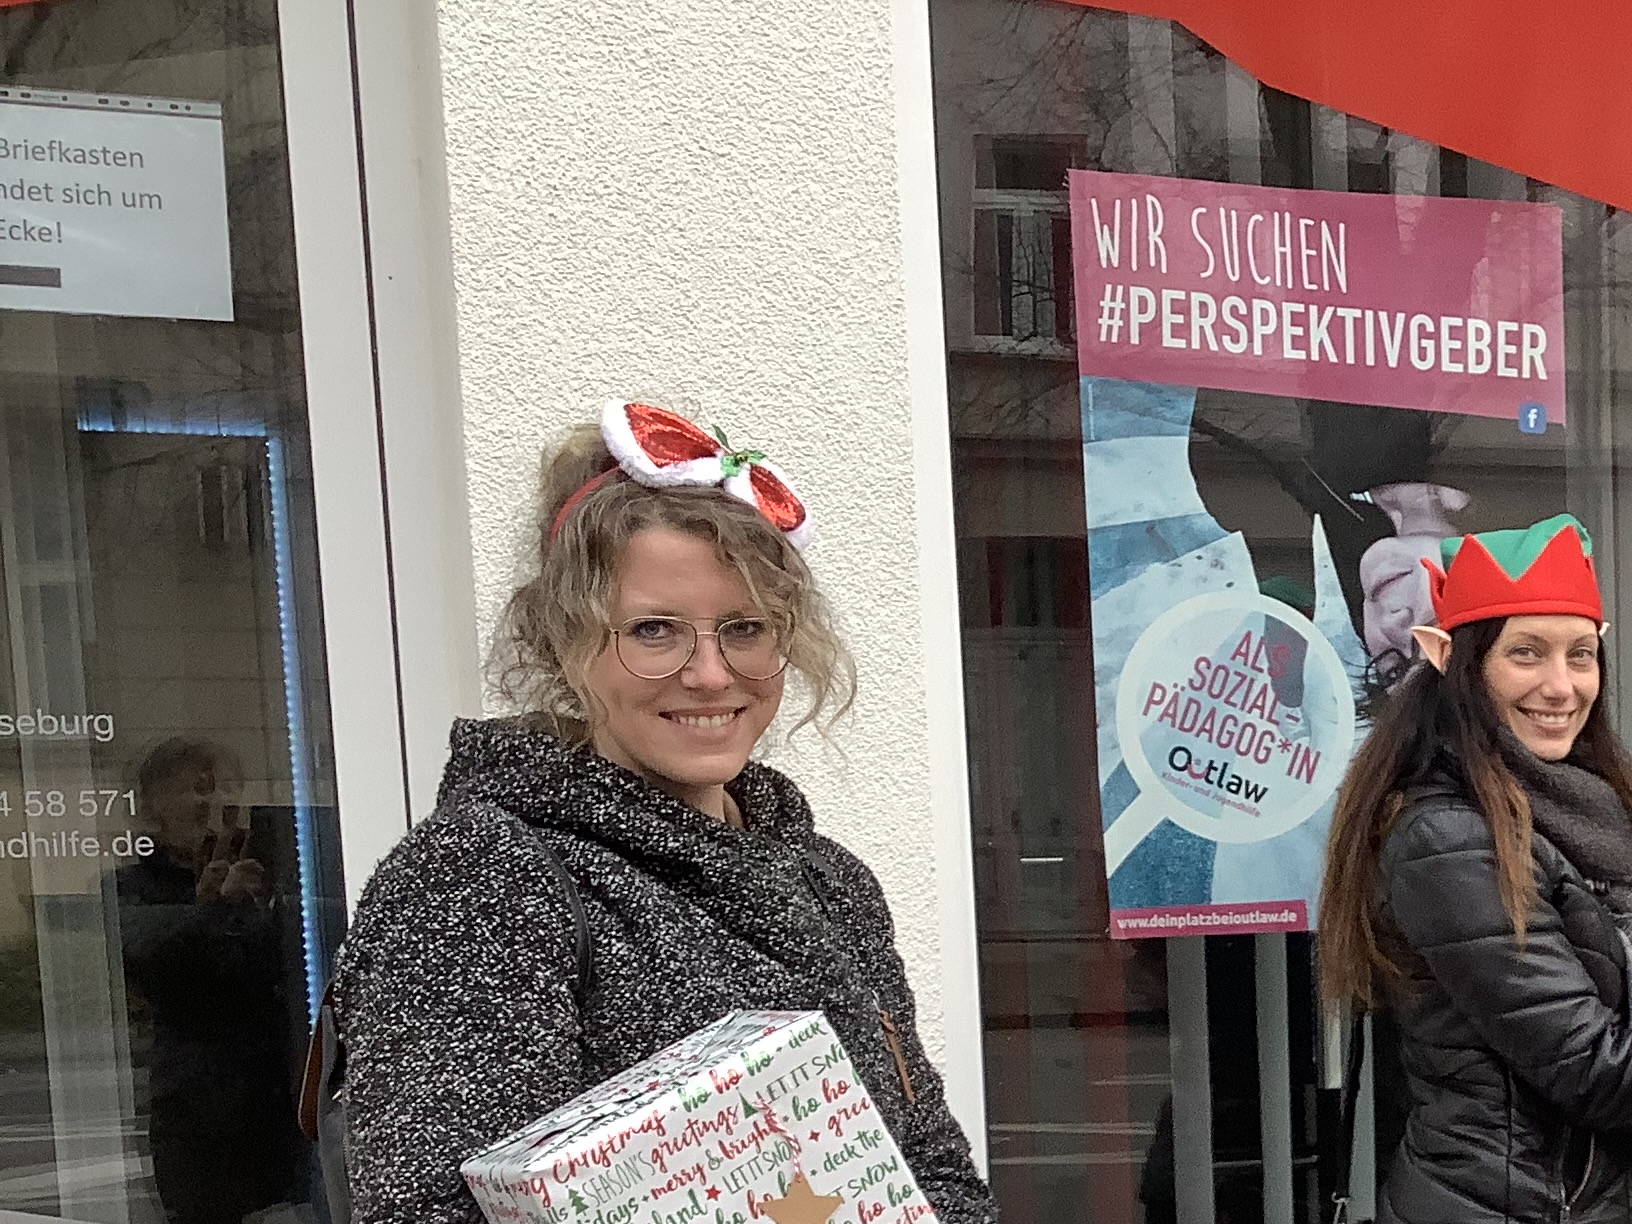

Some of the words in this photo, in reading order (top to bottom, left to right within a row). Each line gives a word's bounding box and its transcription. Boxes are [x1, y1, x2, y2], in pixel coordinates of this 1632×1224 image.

[0, 138, 144, 169] Briefkasten
[62, 183, 112, 206] sich
[121, 191, 163, 210] um
[1090, 193, 1168, 274] WIR
[1191, 206, 1348, 294] SUCHEN
[1098, 284, 1548, 381] #PERSPEKTIVGEBER
[1230, 629, 1290, 680] ALS
[1188, 656, 1300, 726] SOZIAL-
[1168, 745, 1269, 804] Outlaw
[25, 790, 67, 817] 58
[79, 789, 136, 816] 571
[0, 829, 155, 858] dhilfe.de
[1117, 908, 1298, 929] www.deinplatzbeioutlaw.de
[553, 1110, 666, 1184] Christmas
[677, 1087, 711, 1113] ho
[708, 1069, 743, 1094] ho
[740, 1051, 774, 1077] ho
[788, 1020, 828, 1050] deck
[650, 1162, 708, 1201] merry
[704, 1148, 724, 1171] &
[718, 1115, 787, 1162] brigh
[791, 1095, 821, 1121] ho
[821, 1077, 851, 1103] ho
[651, 1105, 740, 1174] greetings
[822, 1143, 864, 1173] deck
[853, 1128, 884, 1152] the
[847, 1154, 899, 1199] SNOW
[886, 1182, 914, 1208] ho
